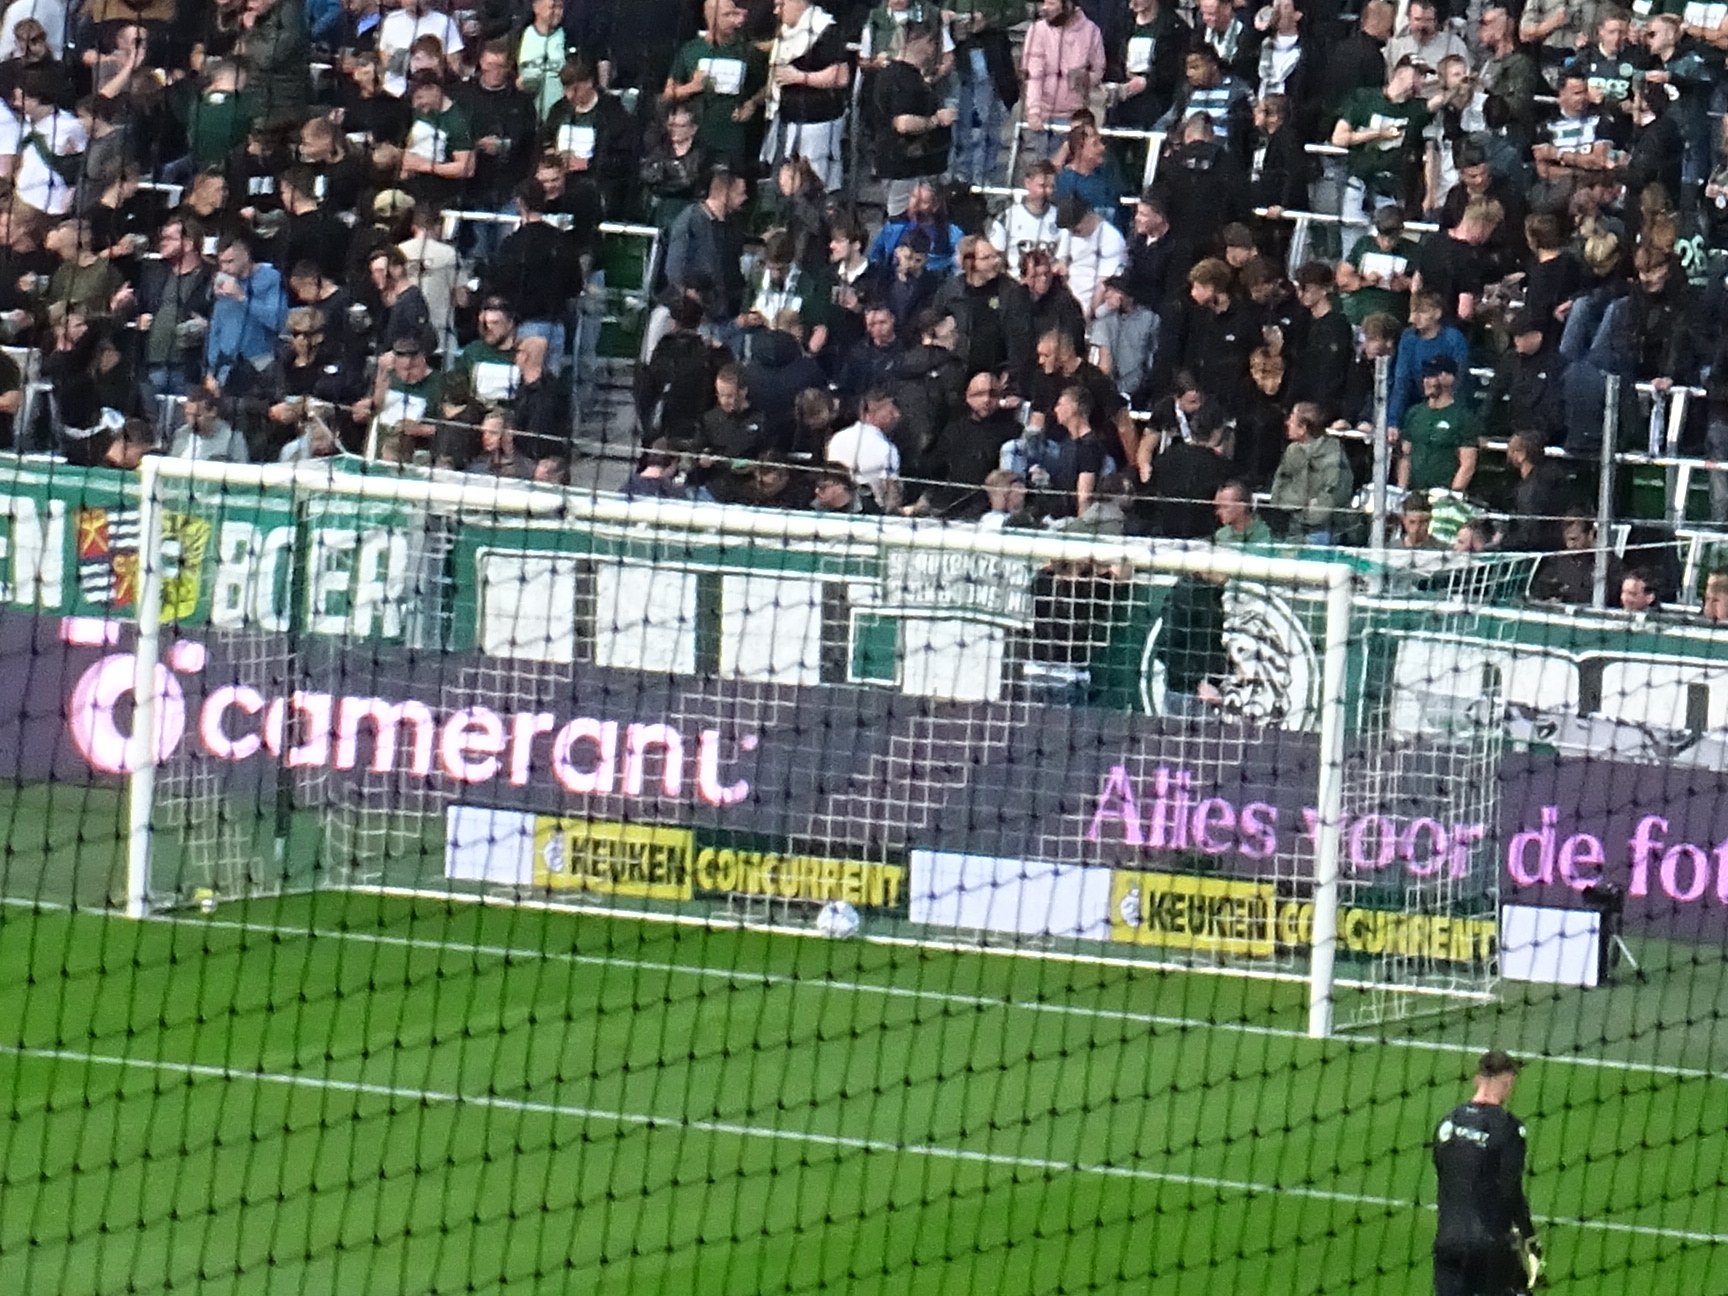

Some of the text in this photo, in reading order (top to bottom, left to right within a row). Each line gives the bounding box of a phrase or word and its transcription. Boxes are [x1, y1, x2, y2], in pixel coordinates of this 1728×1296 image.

[1086, 763, 1278, 858] Alles
[1508, 808, 1605, 892] de
[570, 836, 902, 910] KEUKEN CONCURRENT
[1148, 890, 1269, 942] KEUKEN
